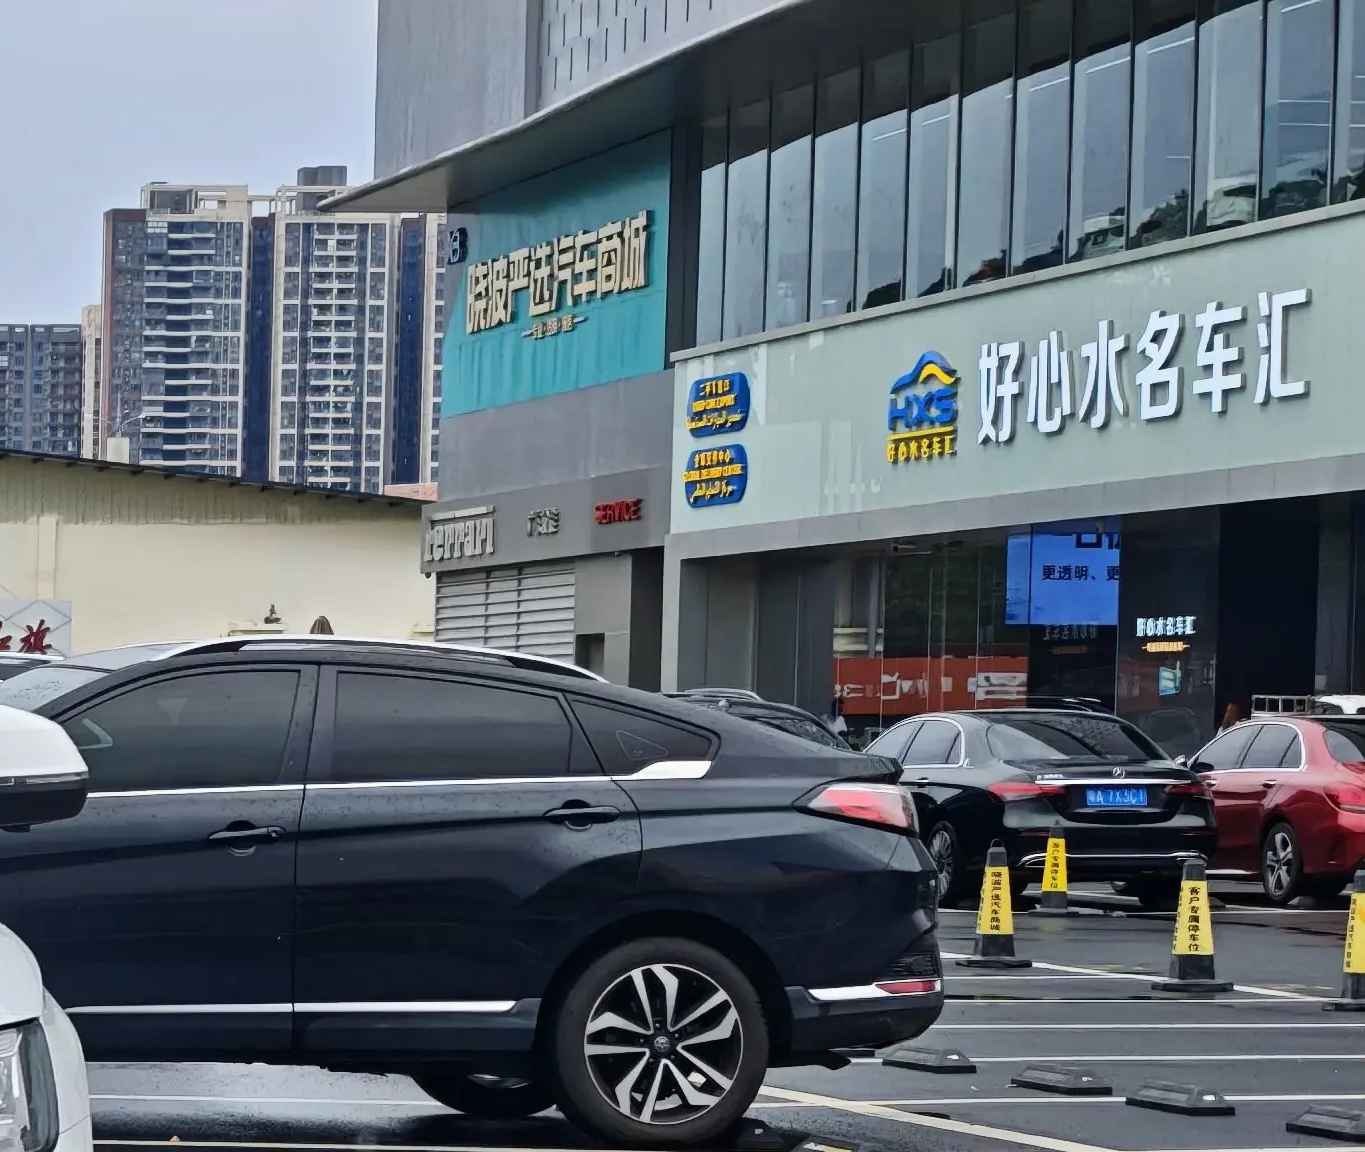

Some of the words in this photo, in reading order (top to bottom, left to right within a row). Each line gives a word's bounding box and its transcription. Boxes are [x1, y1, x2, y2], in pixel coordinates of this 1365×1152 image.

[466, 210, 650, 335] 晓波严选汽车商城
[977, 288, 1312, 445] 好心水名车汇
[594, 499, 643, 525] SERVICE
[1187, 886, 1200, 952] 客户专属停车位
